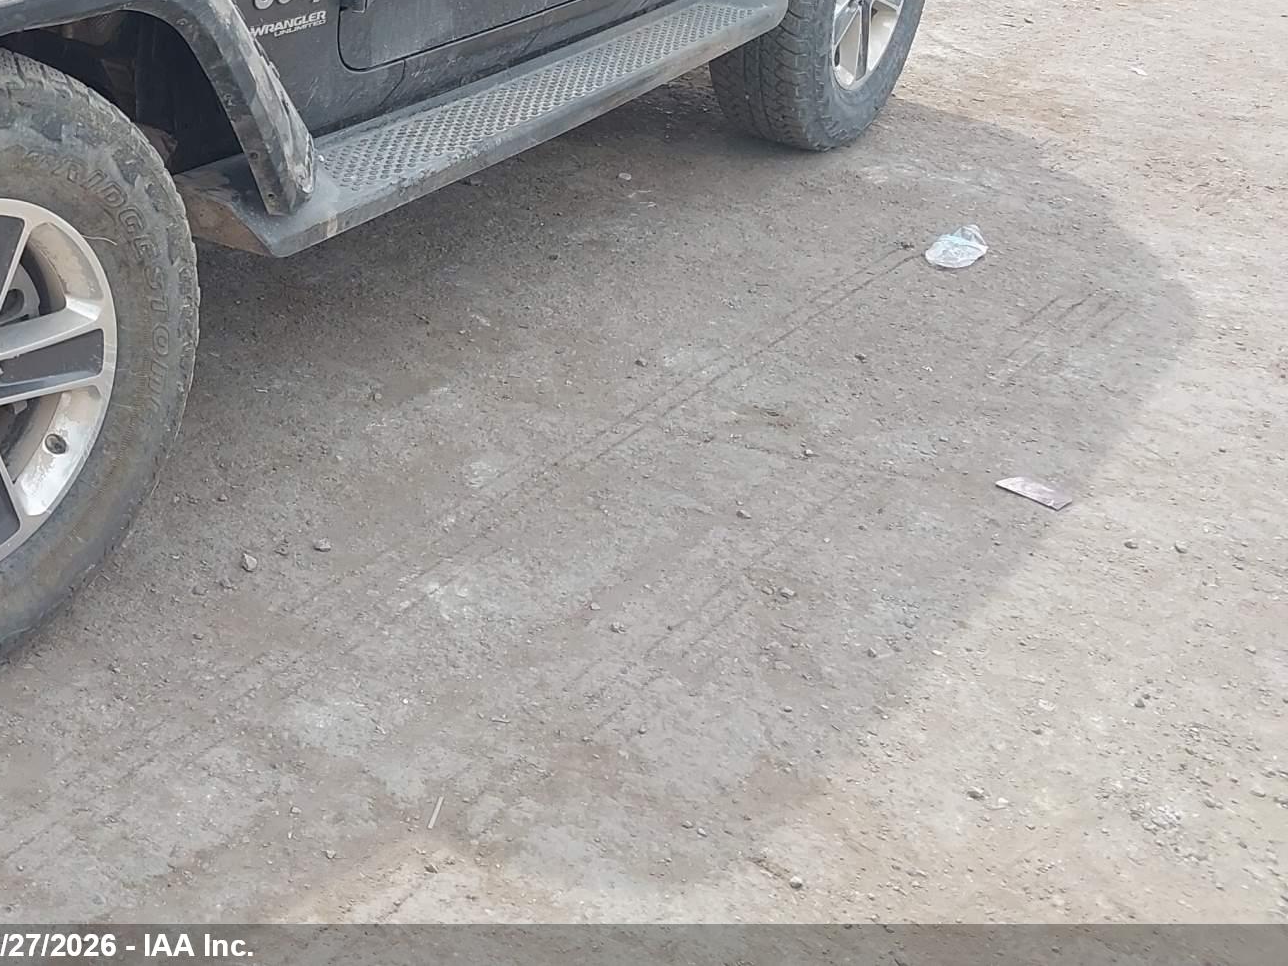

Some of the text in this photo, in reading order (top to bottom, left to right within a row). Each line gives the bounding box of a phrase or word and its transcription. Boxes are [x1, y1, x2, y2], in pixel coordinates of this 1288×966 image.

[249, 10, 327, 37] WRANGLER
[273, 19, 327, 37] UNLIMITED
[25, 148, 169, 412] RIDGESTON
